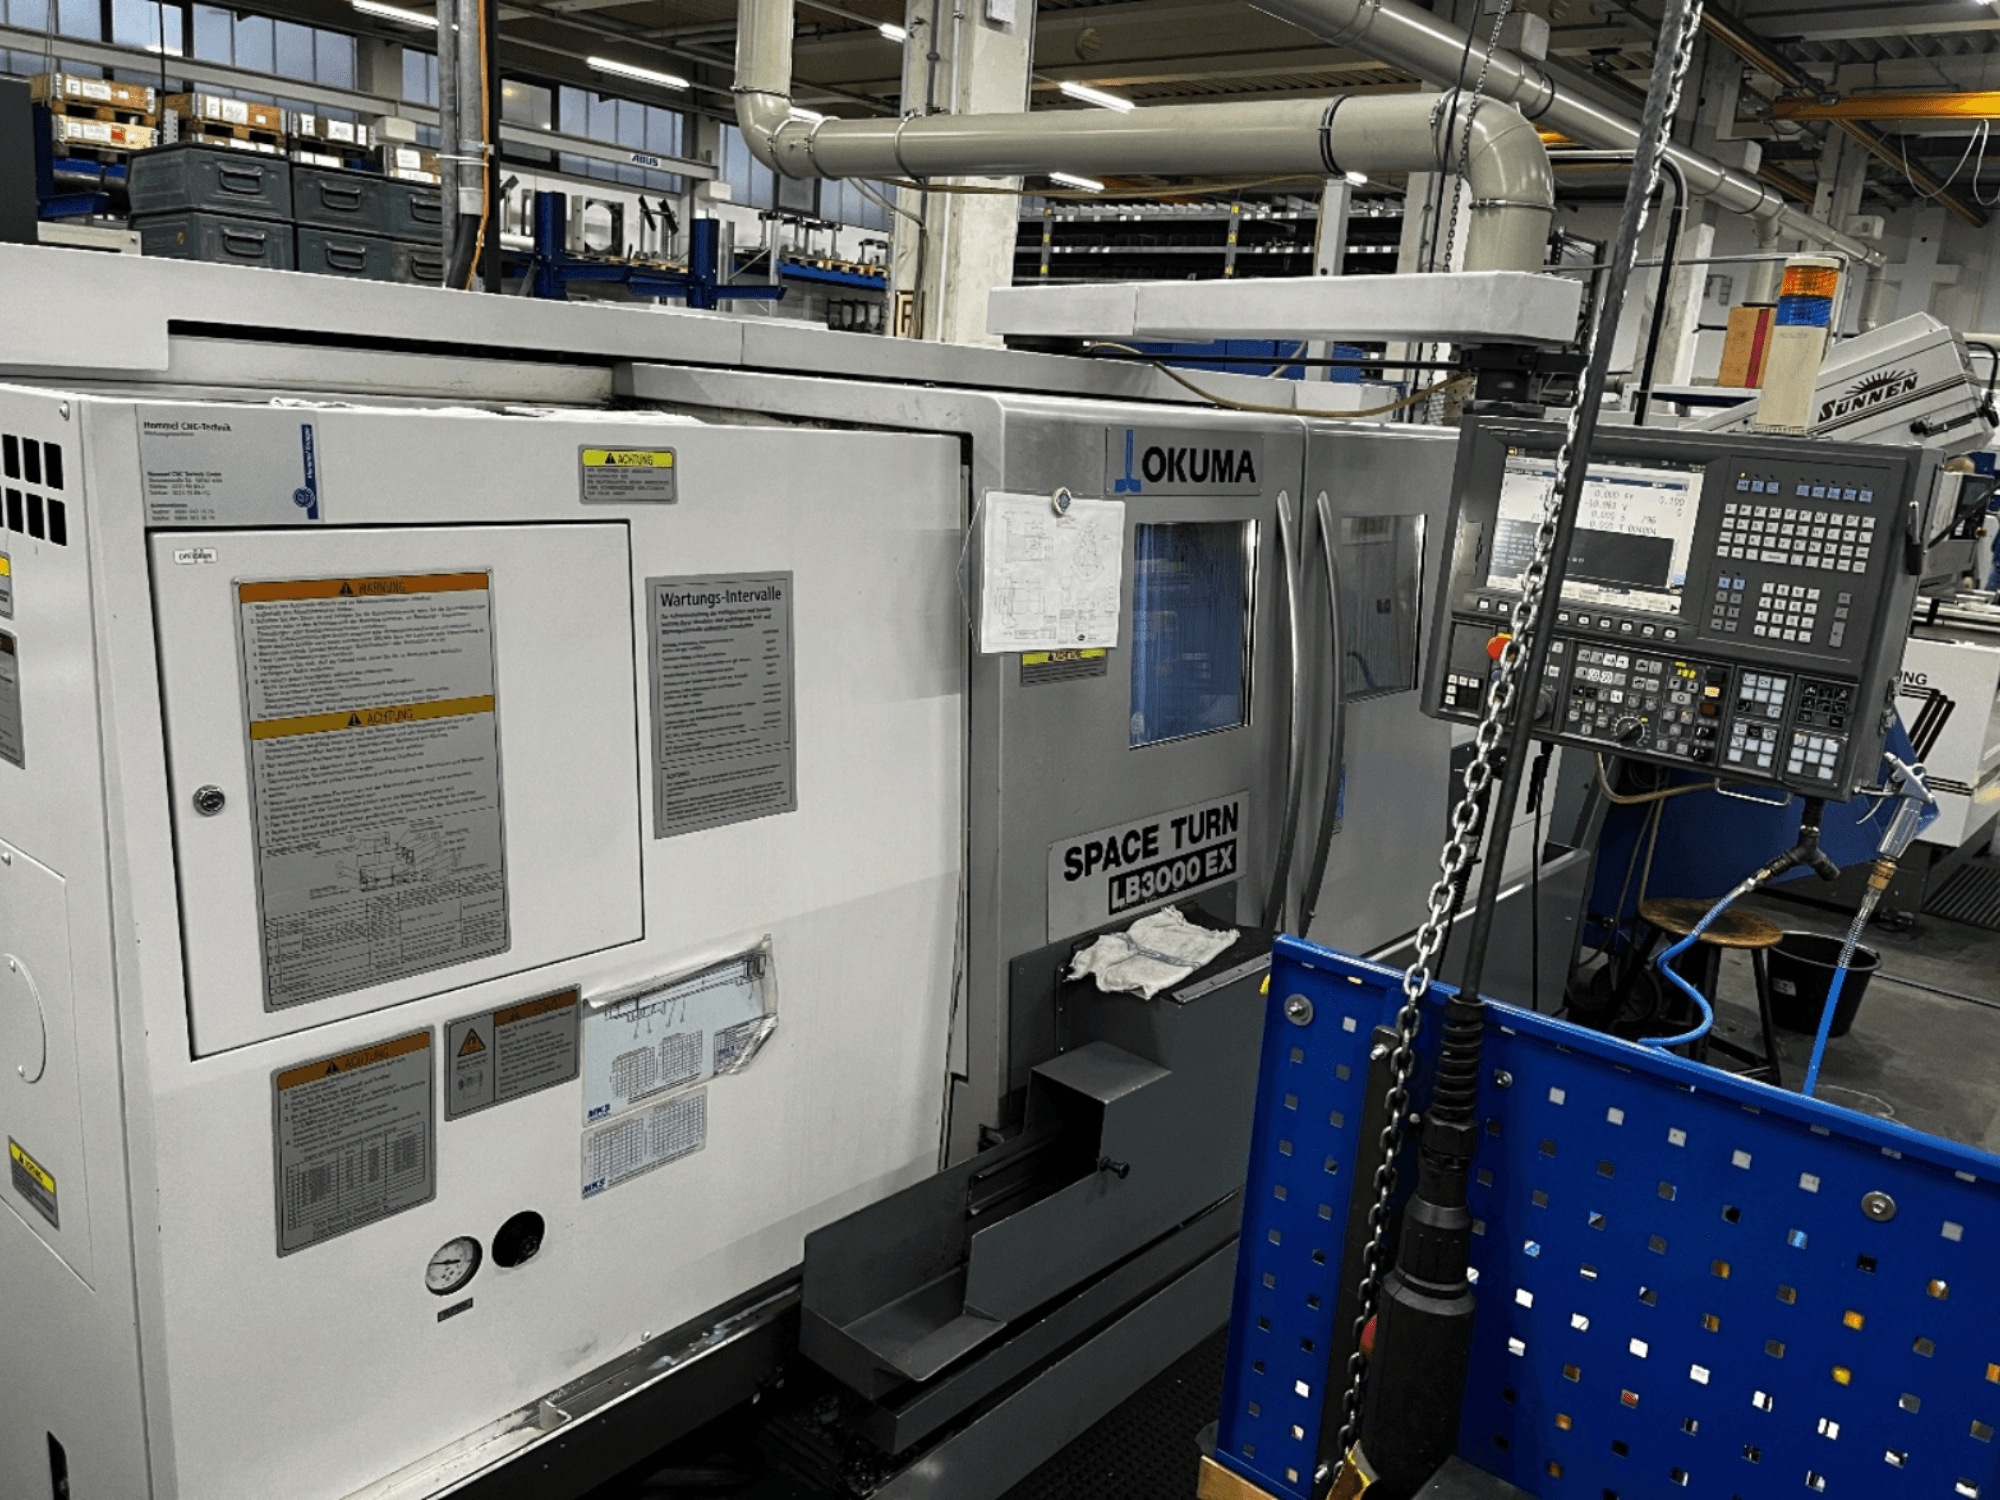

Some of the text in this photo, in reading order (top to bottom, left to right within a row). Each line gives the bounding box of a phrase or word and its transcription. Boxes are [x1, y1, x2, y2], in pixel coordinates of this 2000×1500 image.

[1818, 375, 1919, 423] SUNNEN
[1142, 446, 1257, 484] OKUMA
[358, 581, 407, 595] WARNUNG
[660, 585, 782, 609] Wartungs-Intervalle
[366, 709, 414, 726] ACHTUNG
[1063, 801, 1239, 882] SPACE TURN
[344, 1047, 391, 1069] ACHTUNG
